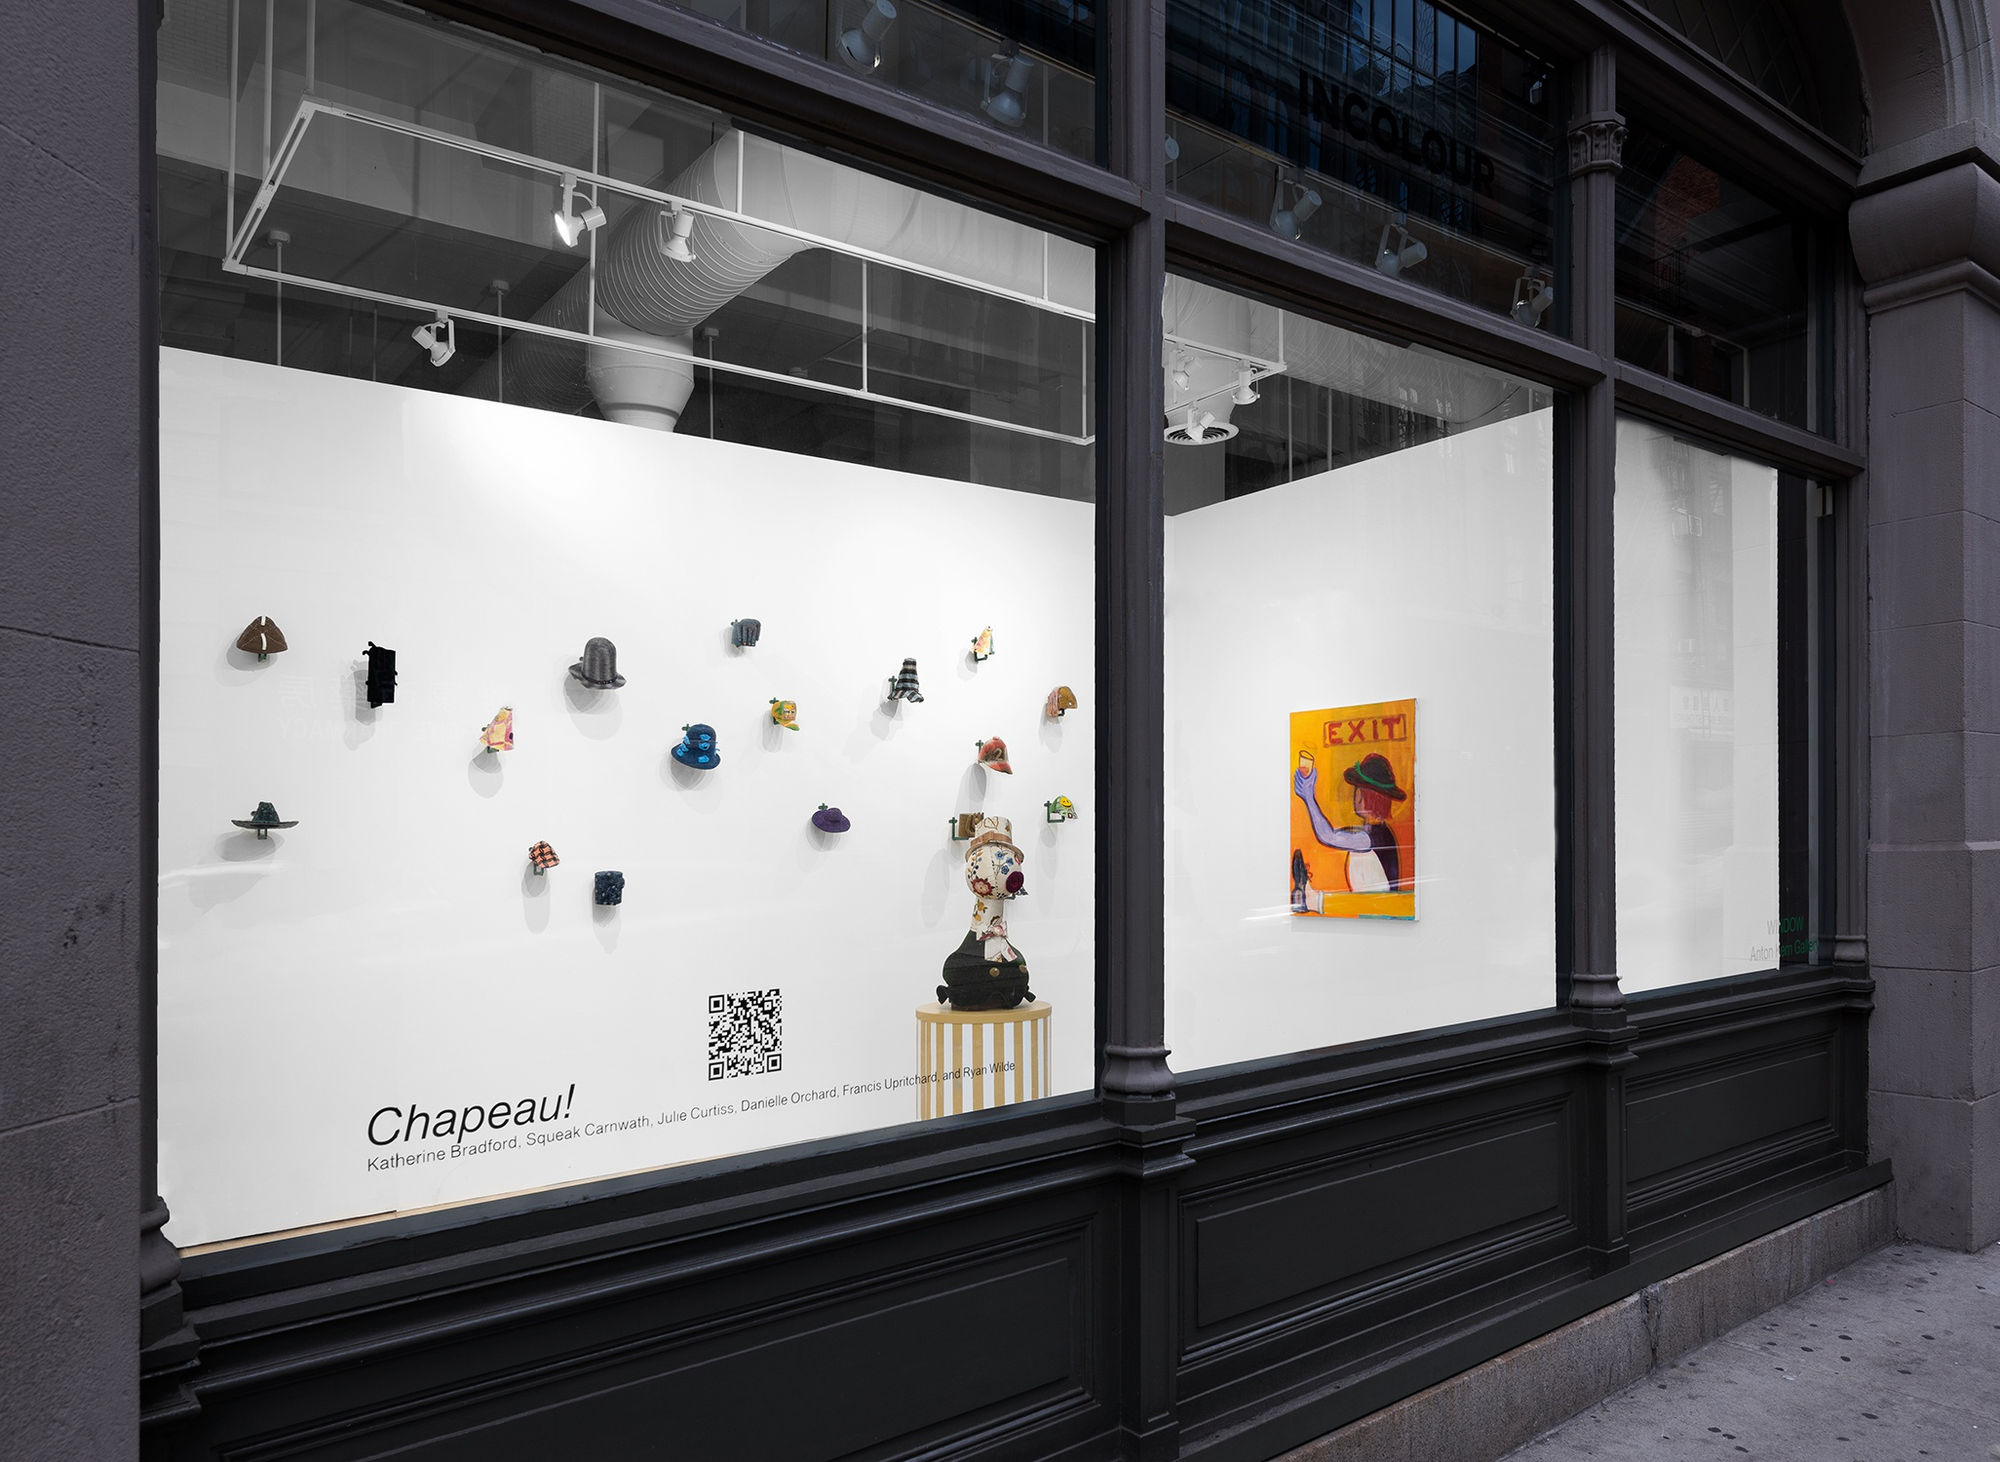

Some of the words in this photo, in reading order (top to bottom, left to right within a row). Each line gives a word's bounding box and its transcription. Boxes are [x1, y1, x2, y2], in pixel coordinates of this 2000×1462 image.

[1299, 67, 1495, 199] INCOLOUR
[1327, 715, 1401, 744] EXIT
[1750, 944, 1774, 962] Anton
[367, 1084, 576, 1146] Chapeau!
[367, 1150, 446, 1172] Katherine
[450, 1135, 522, 1159] Bradford,
[525, 1126, 581, 1147] Squeak
[584, 1115, 654, 1137] Carnwath,
[657, 1110, 688, 1125] Julie
[690, 1103, 738, 1120] Curtiss,
[741, 1094, 788, 1112] Danielle
[790, 1086, 840, 1104] Orchard,
[842, 1079, 882, 1096] Francis
[884, 1071, 940, 1091] Upritchard,
[942, 1068, 961, 1081] and
[963, 1064, 988, 1079] Ryan
[989, 1060, 1016, 1075] Wilde
